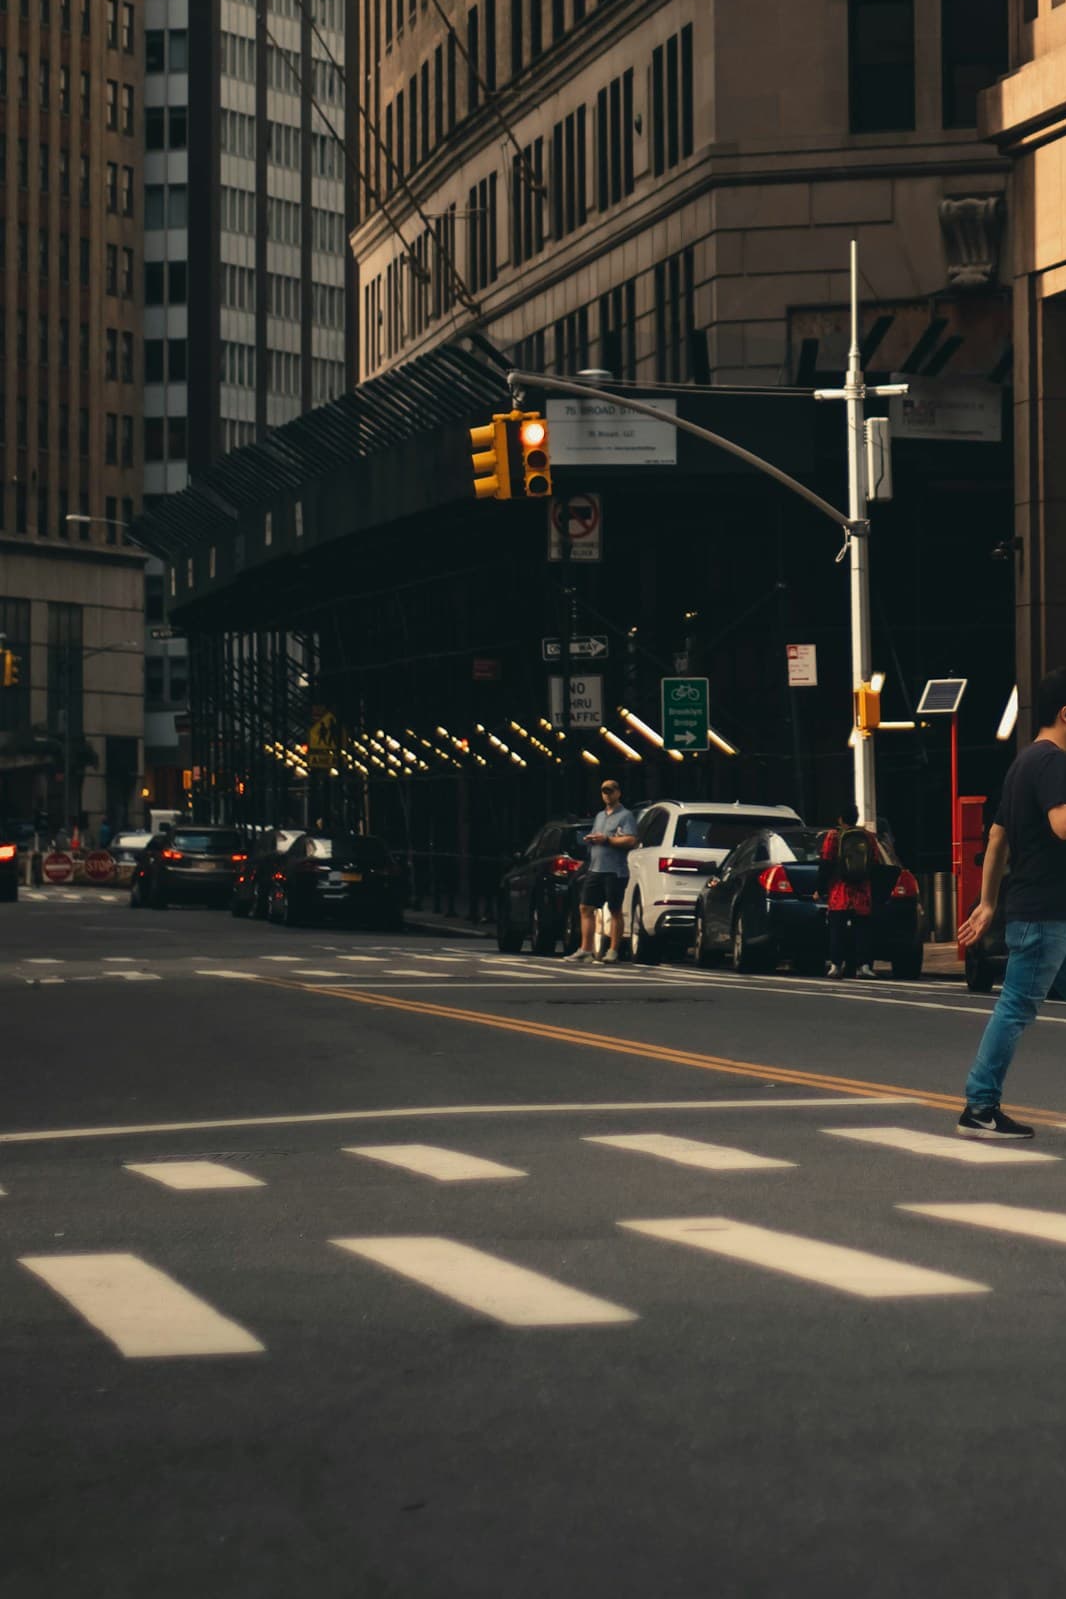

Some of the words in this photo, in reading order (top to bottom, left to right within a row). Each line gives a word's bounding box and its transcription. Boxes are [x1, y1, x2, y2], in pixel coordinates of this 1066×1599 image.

[569, 682, 585, 695] NO
[569, 698, 592, 709] HRU
[554, 712, 600, 723] TAFFIC
[87, 859, 113, 873] STOP
